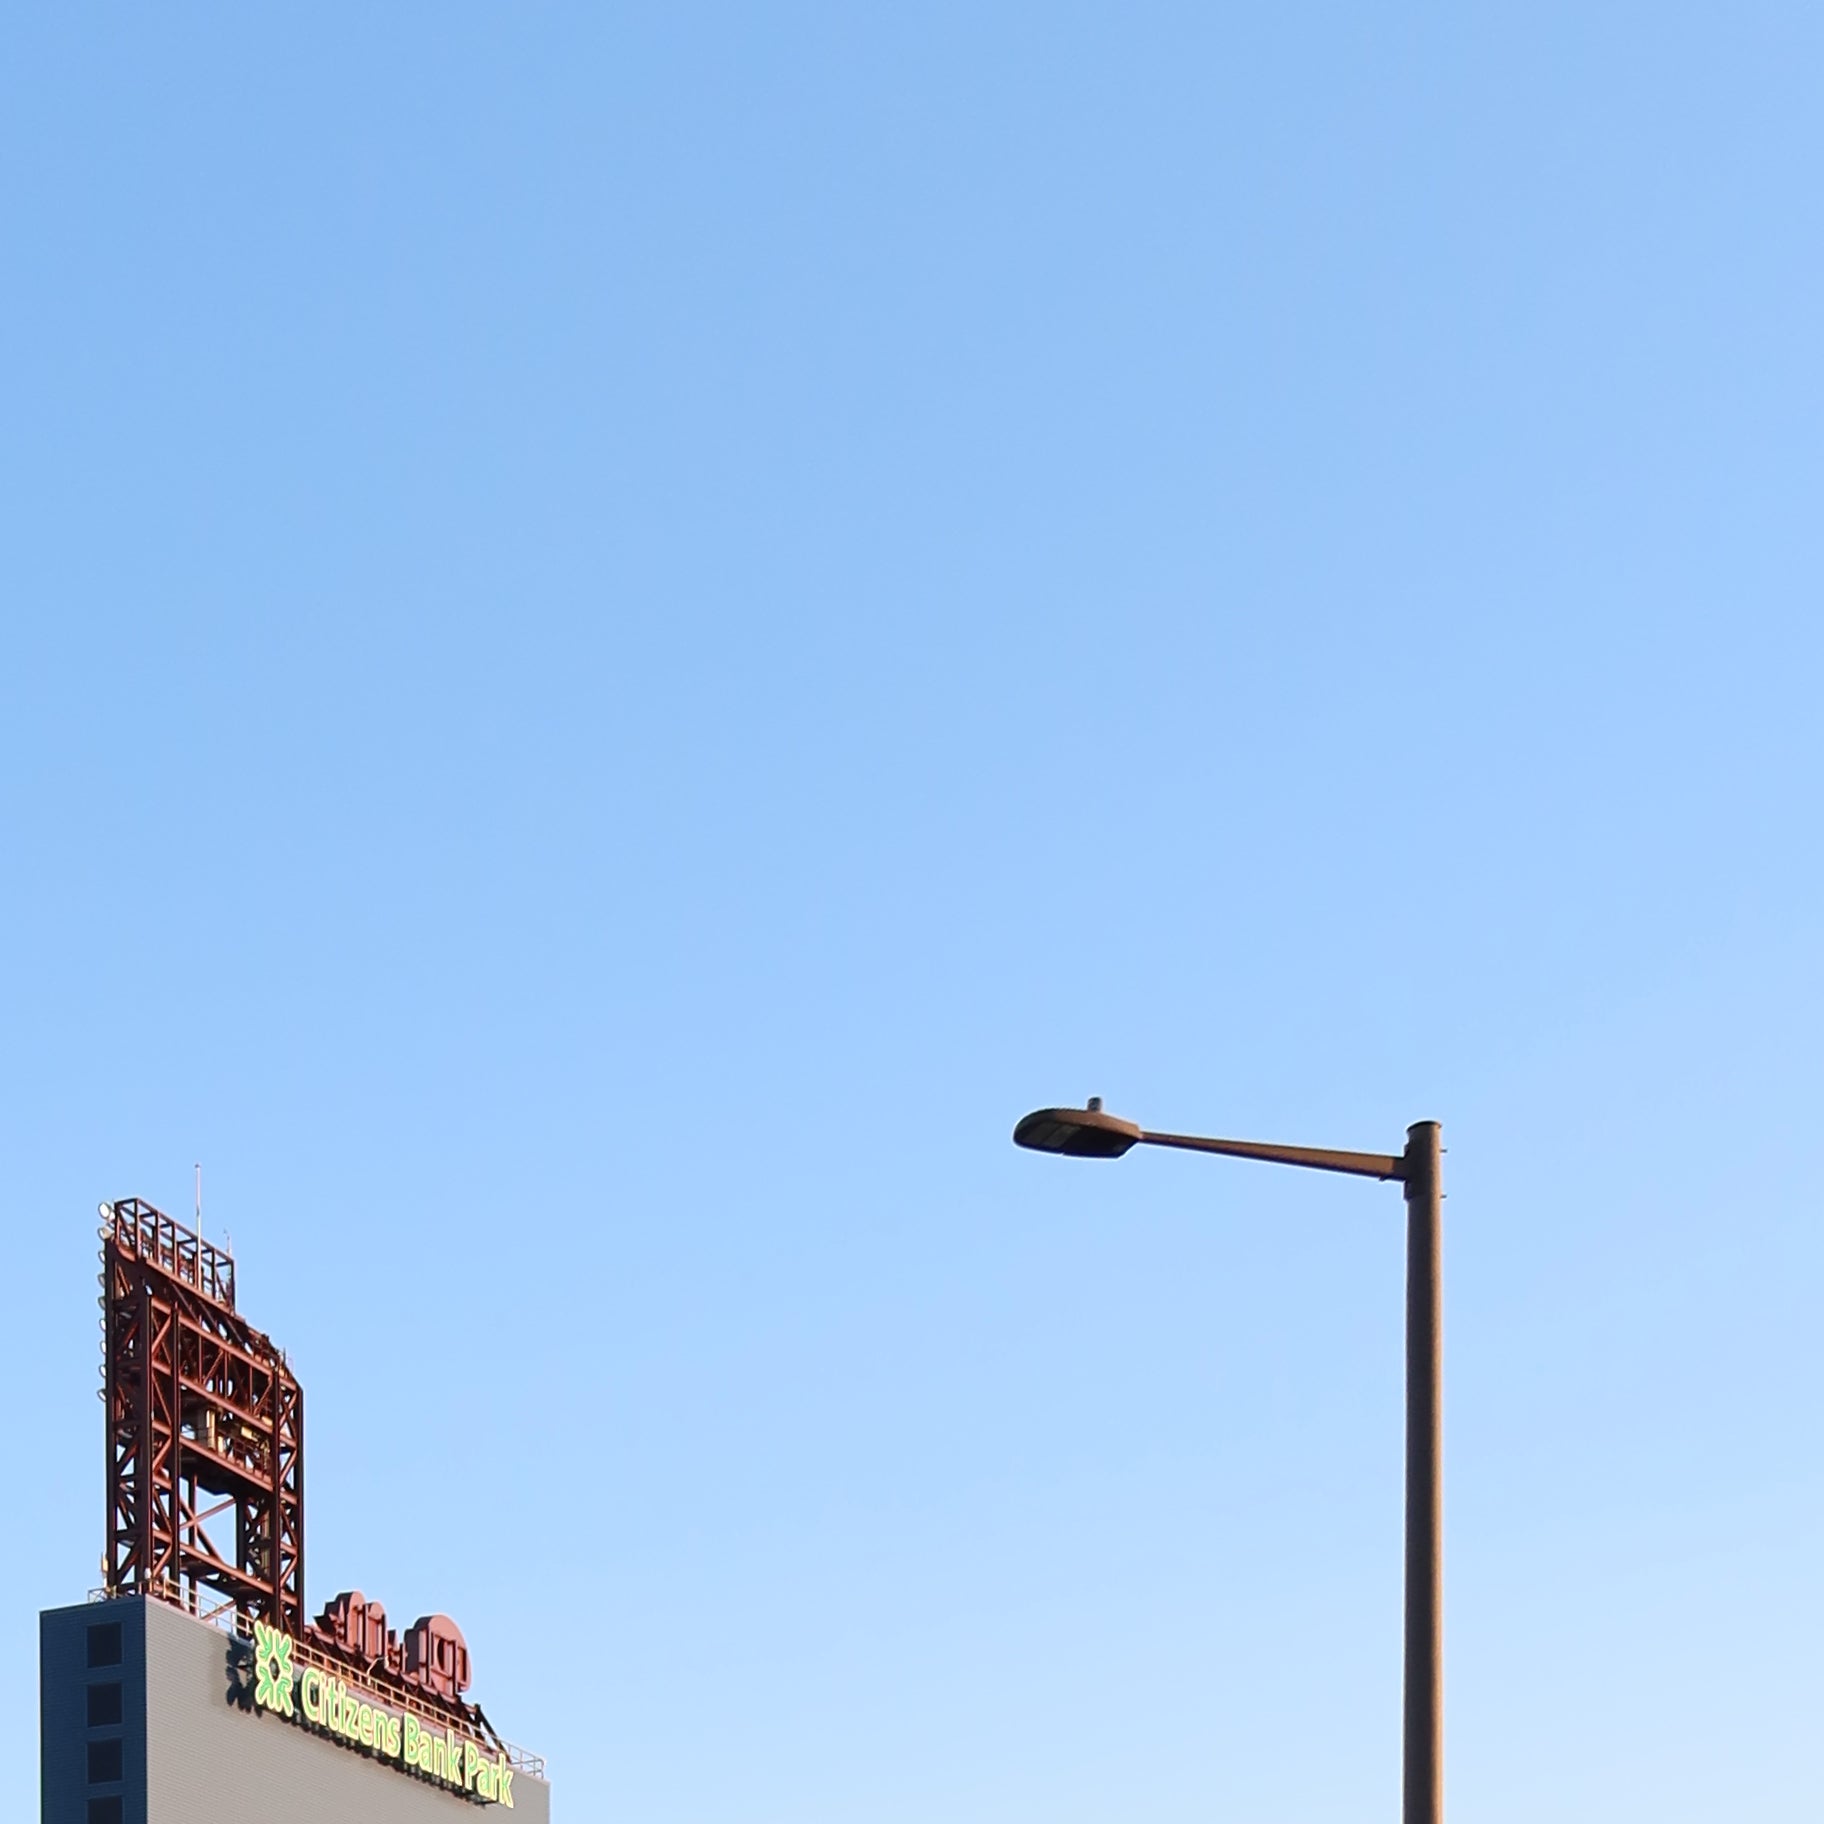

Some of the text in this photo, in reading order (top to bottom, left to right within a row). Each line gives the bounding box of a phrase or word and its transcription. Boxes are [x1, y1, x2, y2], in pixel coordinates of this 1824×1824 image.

[300, 1666, 514, 1808] Citizens Bank Park
